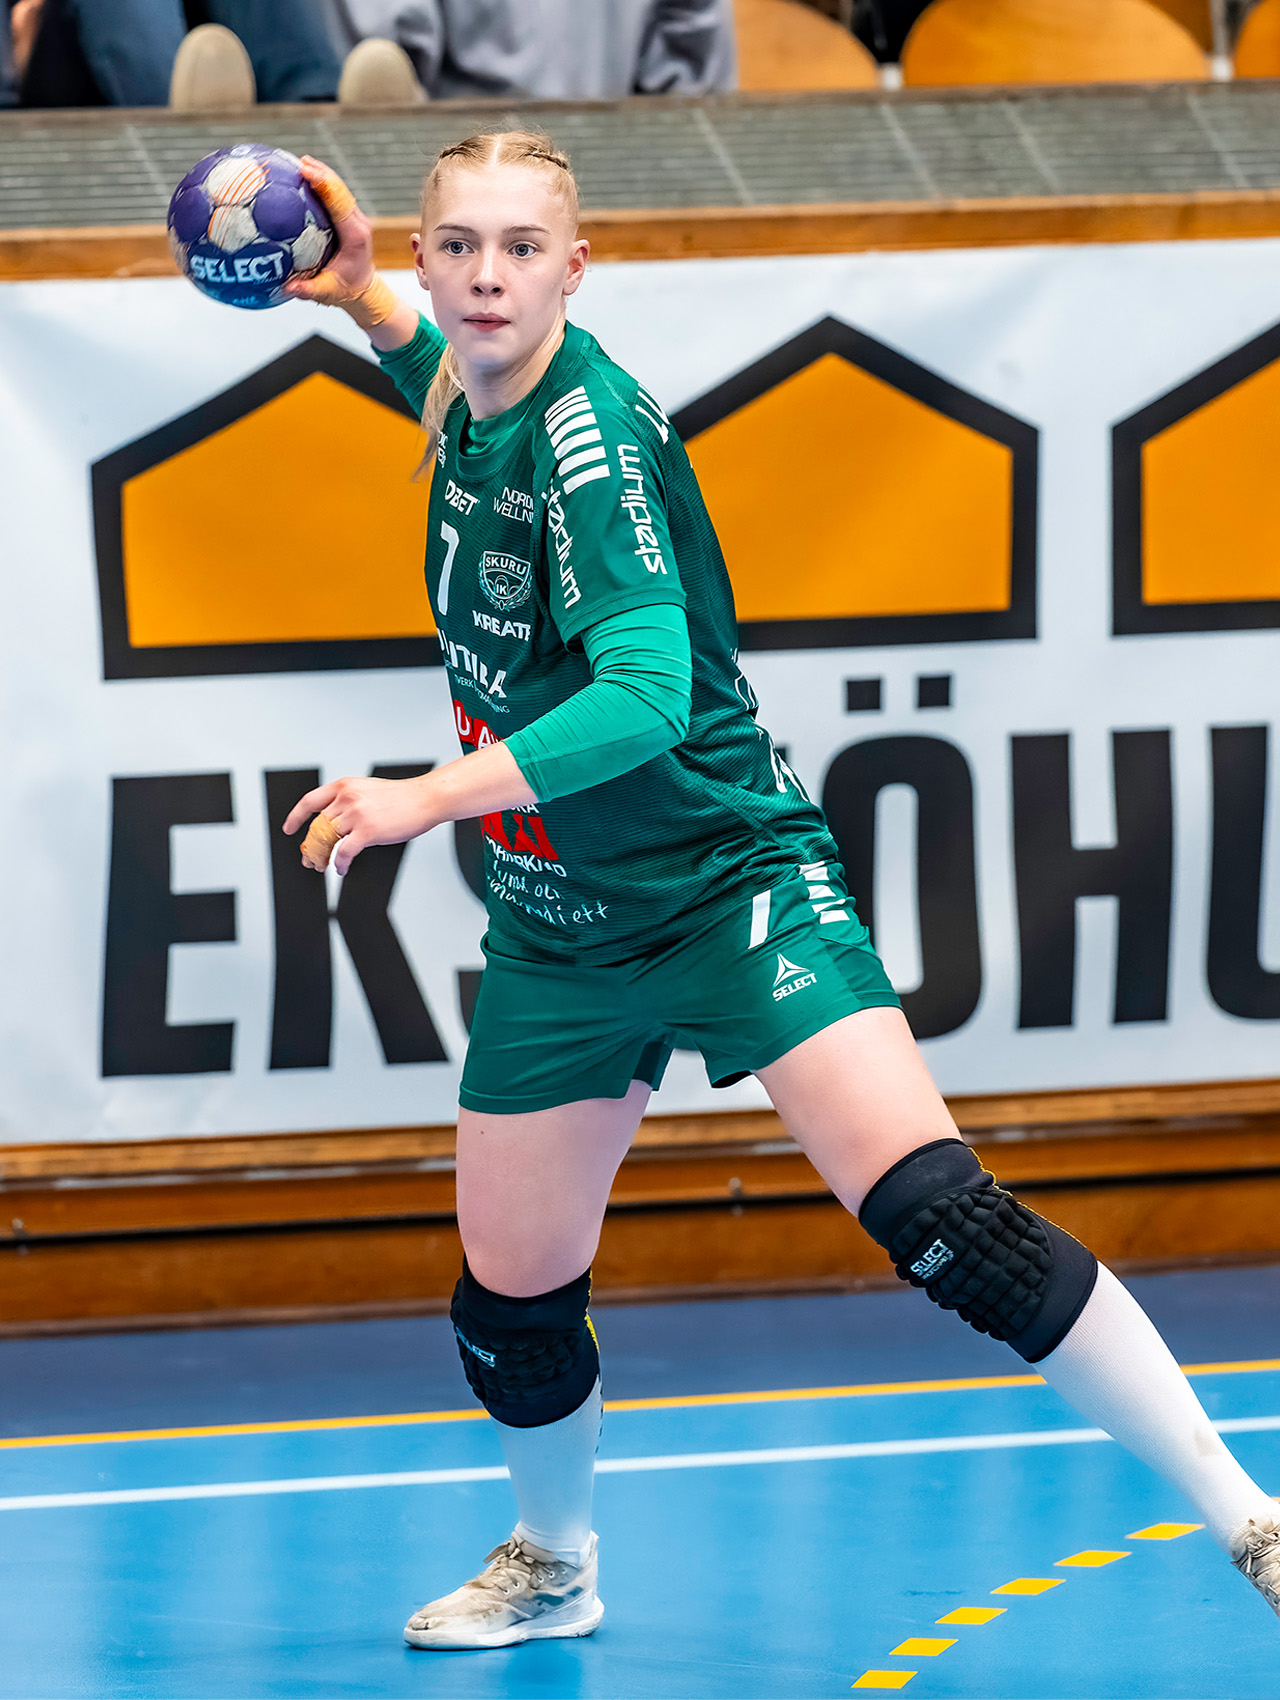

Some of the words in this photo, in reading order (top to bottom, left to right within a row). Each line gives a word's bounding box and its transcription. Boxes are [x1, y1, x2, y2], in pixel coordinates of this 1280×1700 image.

[190, 251, 284, 284] SELECT
[444, 479, 479, 516] DBET
[617, 443, 668, 575] stadium
[541, 478, 582, 609] tadium
[437, 520, 460, 616] 7
[485, 556, 527, 576] SKURU
[496, 583, 508, 597] IK
[772, 972, 818, 1002] SELECT
[910, 1238, 949, 1277] SELECT
